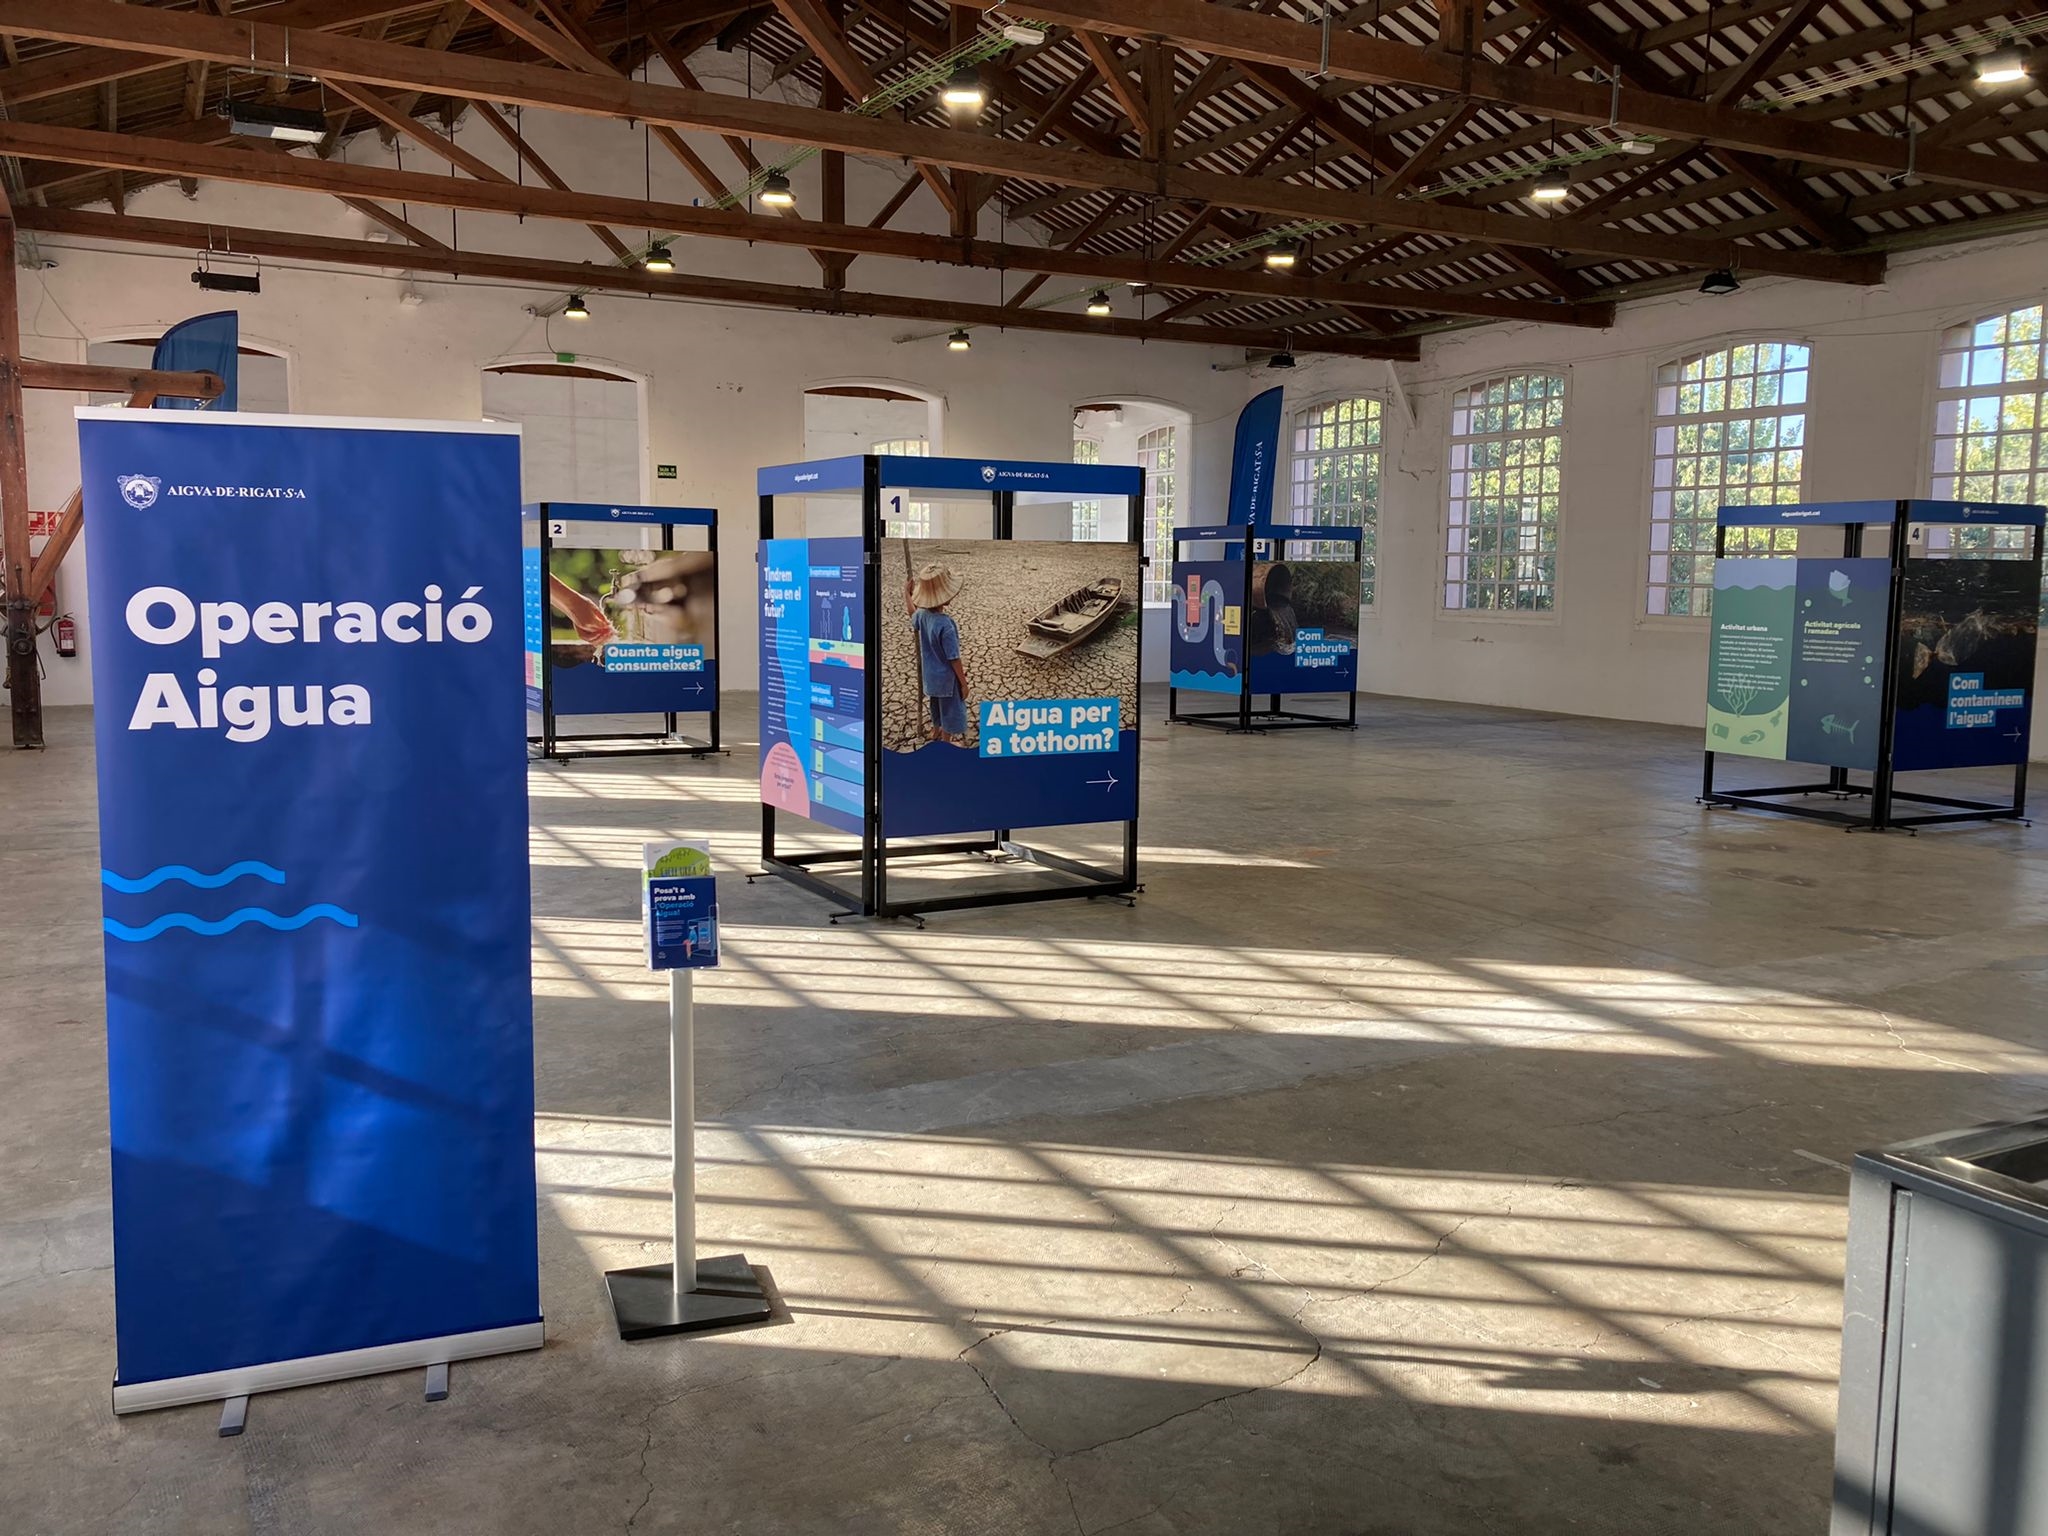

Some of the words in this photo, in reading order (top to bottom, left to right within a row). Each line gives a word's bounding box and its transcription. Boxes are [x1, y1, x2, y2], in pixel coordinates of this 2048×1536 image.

[890, 496, 901, 513] 1
[553, 524, 563, 534] 2
[1911, 528, 1920, 541] 4
[1256, 541, 1263, 550] 3
[763, 567, 792, 582] Tindrem
[763, 585, 783, 602] aigua
[784, 589, 793, 600] en
[794, 586, 802, 601] el
[764, 603, 785, 618] futur?
[125, 584, 493, 658] Operació
[1296, 630, 1321, 641] Com
[607, 646, 659, 659] Quanta
[662, 647, 700, 660] aigua
[607, 659, 702, 672] consumeixes?
[1951, 676, 1980, 690] Com
[127, 668, 371, 742] Aigua
[1950, 691, 2023, 708] contaminem
[986, 702, 1062, 731] Aigua
[1070, 705, 1112, 729] per
[986, 737, 1002, 755] a
[1009, 727, 1114, 753] tothom?
